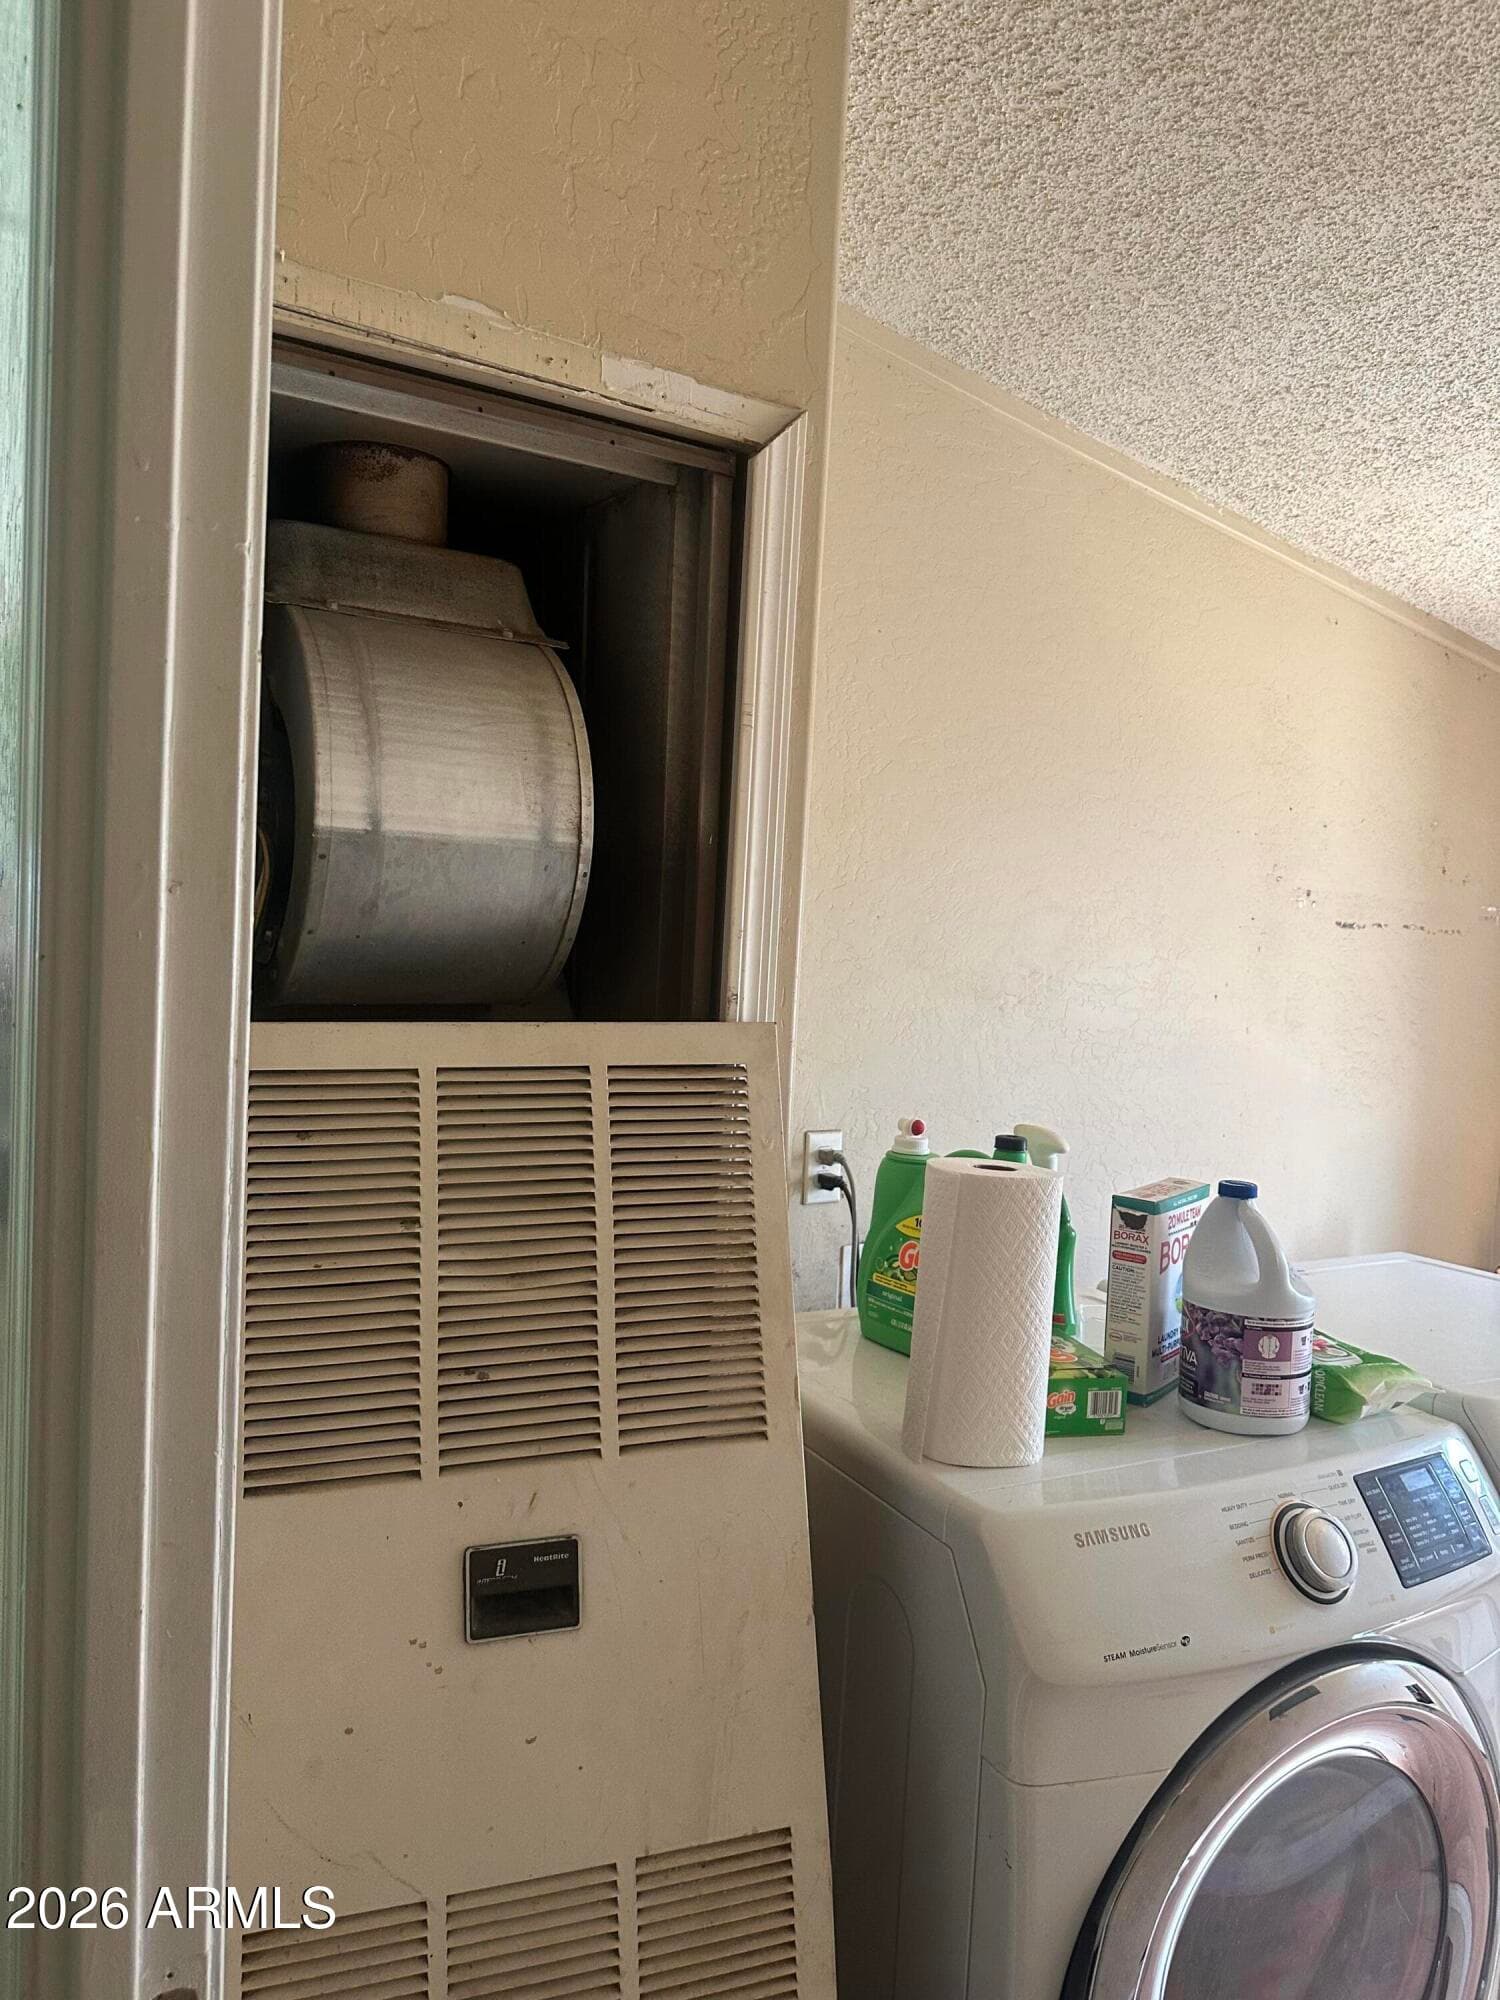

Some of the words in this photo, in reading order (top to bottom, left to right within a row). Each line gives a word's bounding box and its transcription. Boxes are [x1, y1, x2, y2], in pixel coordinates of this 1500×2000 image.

[1113, 1230, 1149, 1246] BORAX
[1046, 1389, 1076, 1409] Gain
[1073, 1522, 1152, 1549] SAMSUNG
[1103, 1650, 1128, 1663] STEAM
[1128, 1641, 1177, 1658] MoistureSensor
